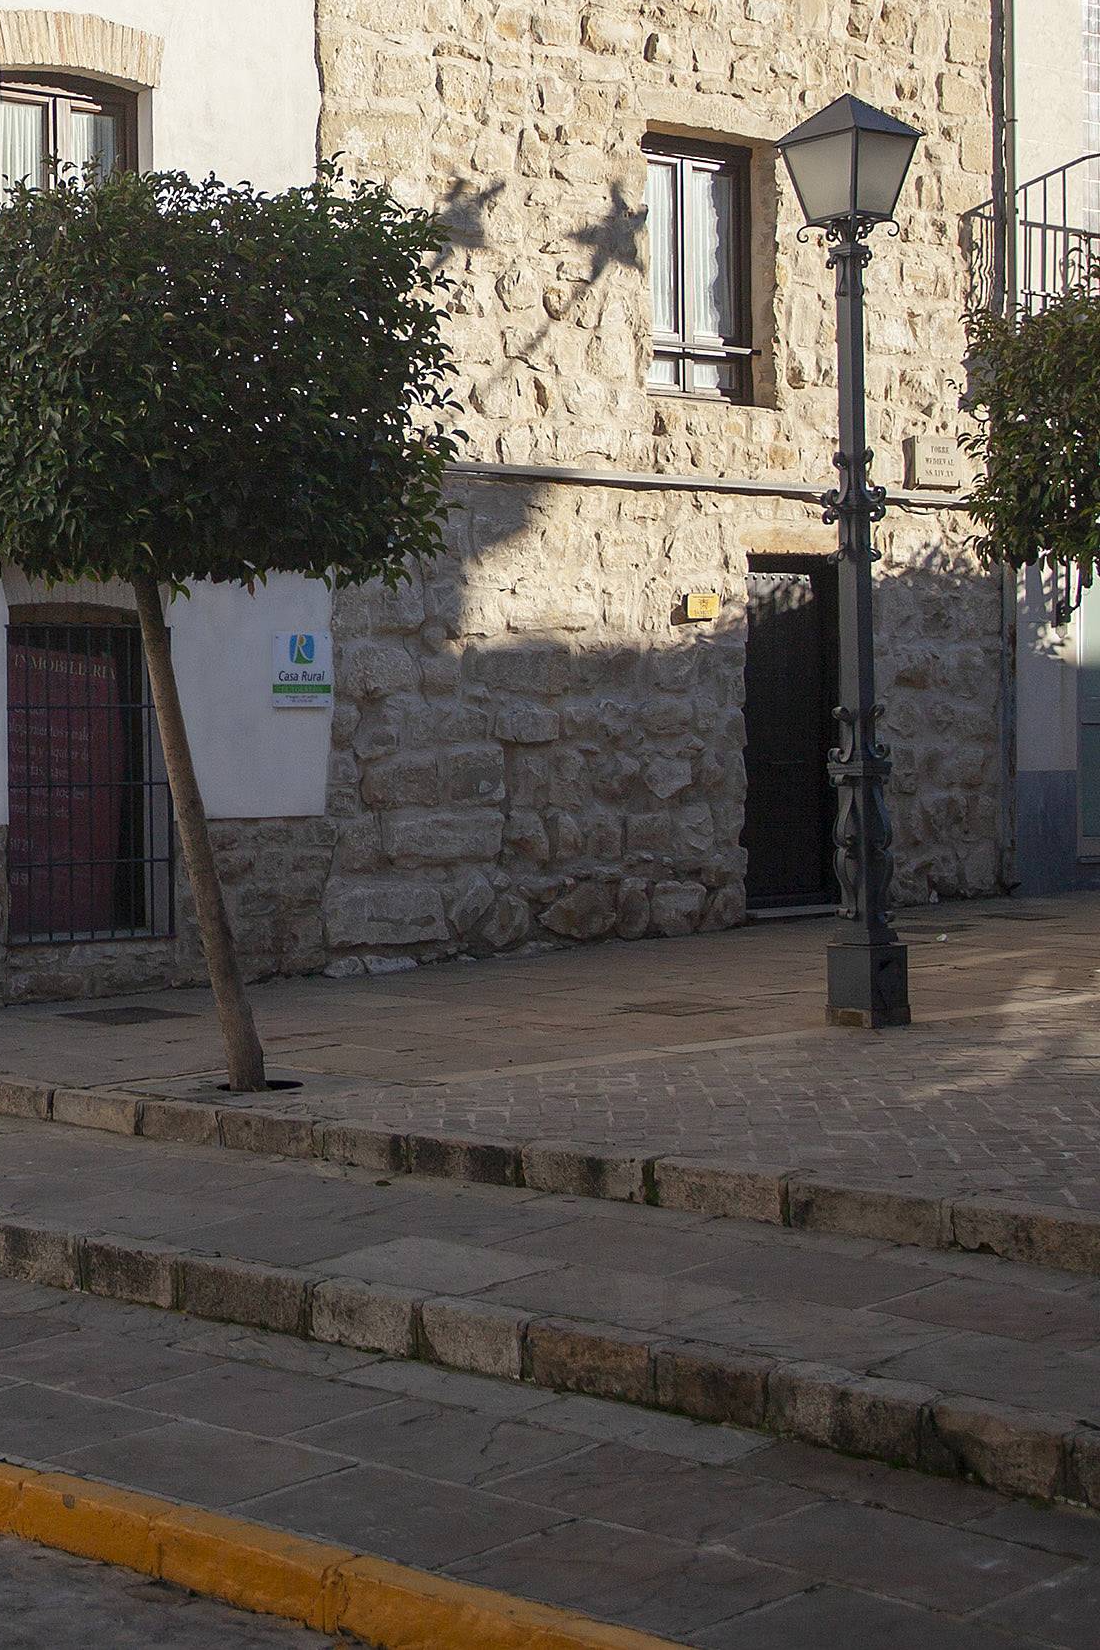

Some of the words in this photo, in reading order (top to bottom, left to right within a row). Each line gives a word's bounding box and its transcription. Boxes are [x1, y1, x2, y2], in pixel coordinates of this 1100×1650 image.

[925, 457, 954, 466] MEDIEVAL
[278, 670, 299, 682] Casa
[301, 670, 326, 682] Rural
